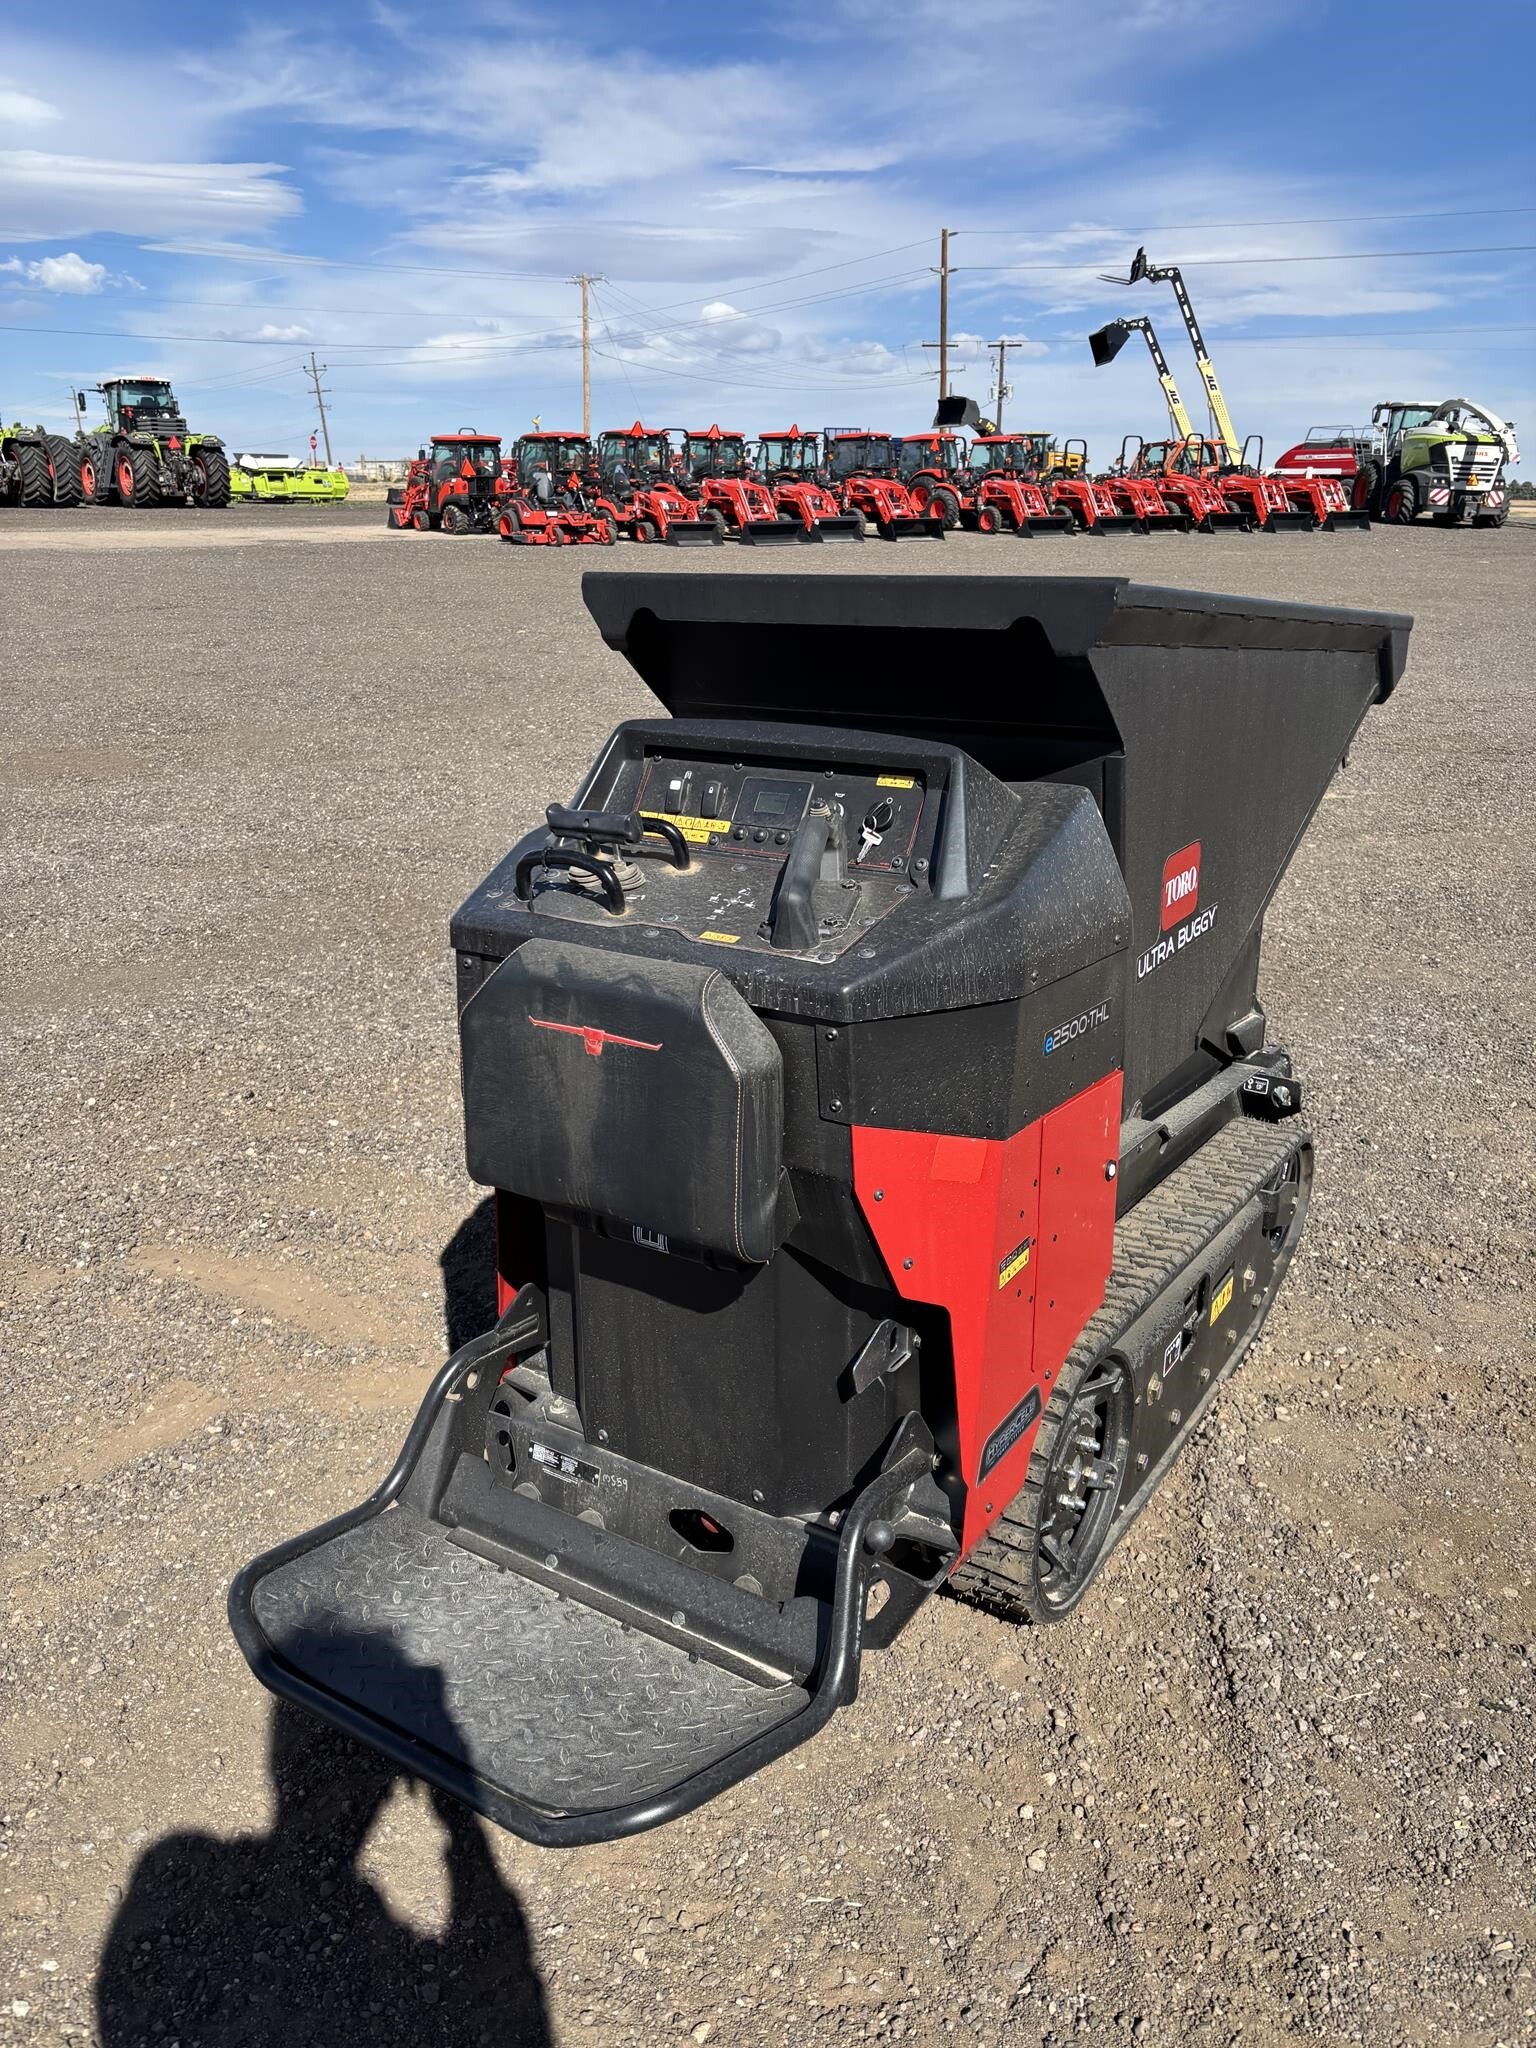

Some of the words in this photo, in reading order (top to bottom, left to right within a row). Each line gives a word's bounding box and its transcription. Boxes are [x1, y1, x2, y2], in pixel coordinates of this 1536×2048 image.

[1168, 389, 1180, 405] JLG
[1206, 374, 1218, 391] JLG
[1165, 866, 1197, 908] TORO
[1137, 935, 1175, 979] ULTRA
[1177, 908, 1218, 950] BUGGY
